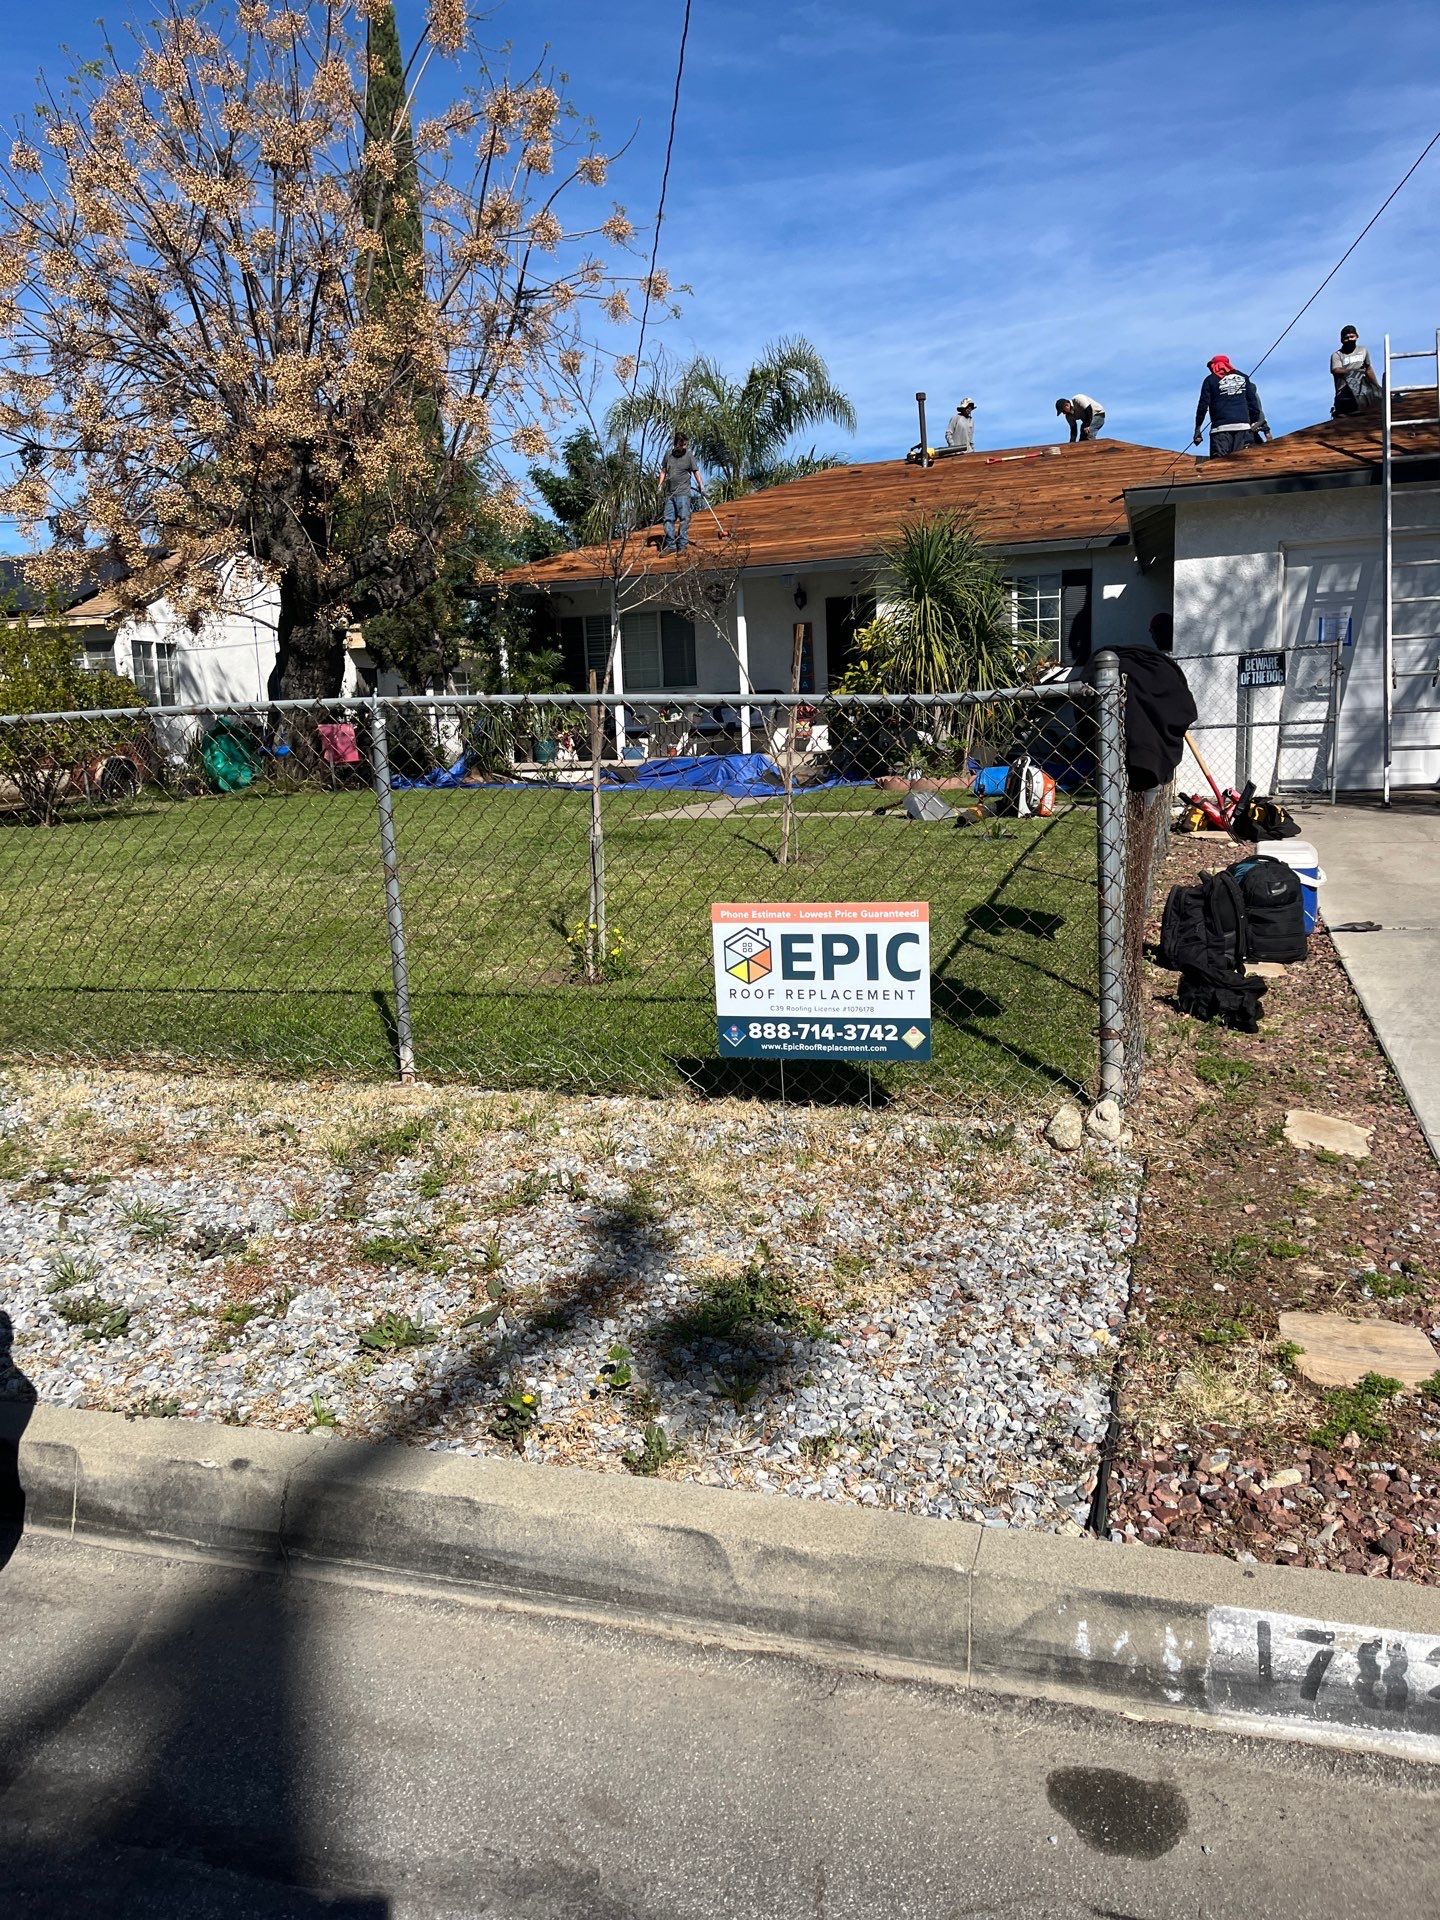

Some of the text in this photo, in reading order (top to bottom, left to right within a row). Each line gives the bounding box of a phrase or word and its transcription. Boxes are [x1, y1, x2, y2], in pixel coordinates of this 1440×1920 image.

[1245, 656, 1279, 672] BEWARE
[1240, 669, 1284, 685] OF THE DOG
[720, 910, 749, 919] Phone
[751, 910, 791, 919] Estimate
[799, 909, 833, 919] Lowest
[834, 909, 858, 918] Price
[860, 909, 919, 918] Guaranteed!
[780, 932, 922, 982] EPIC
[729, 988, 916, 1001] ROOF REPLACEMENT
[786, 1005, 812, 1013] Roofing
[748, 1022, 899, 1041] 888-714-3742
[761, 1042, 887, 1053] www.EpicRoofReplacement.com
